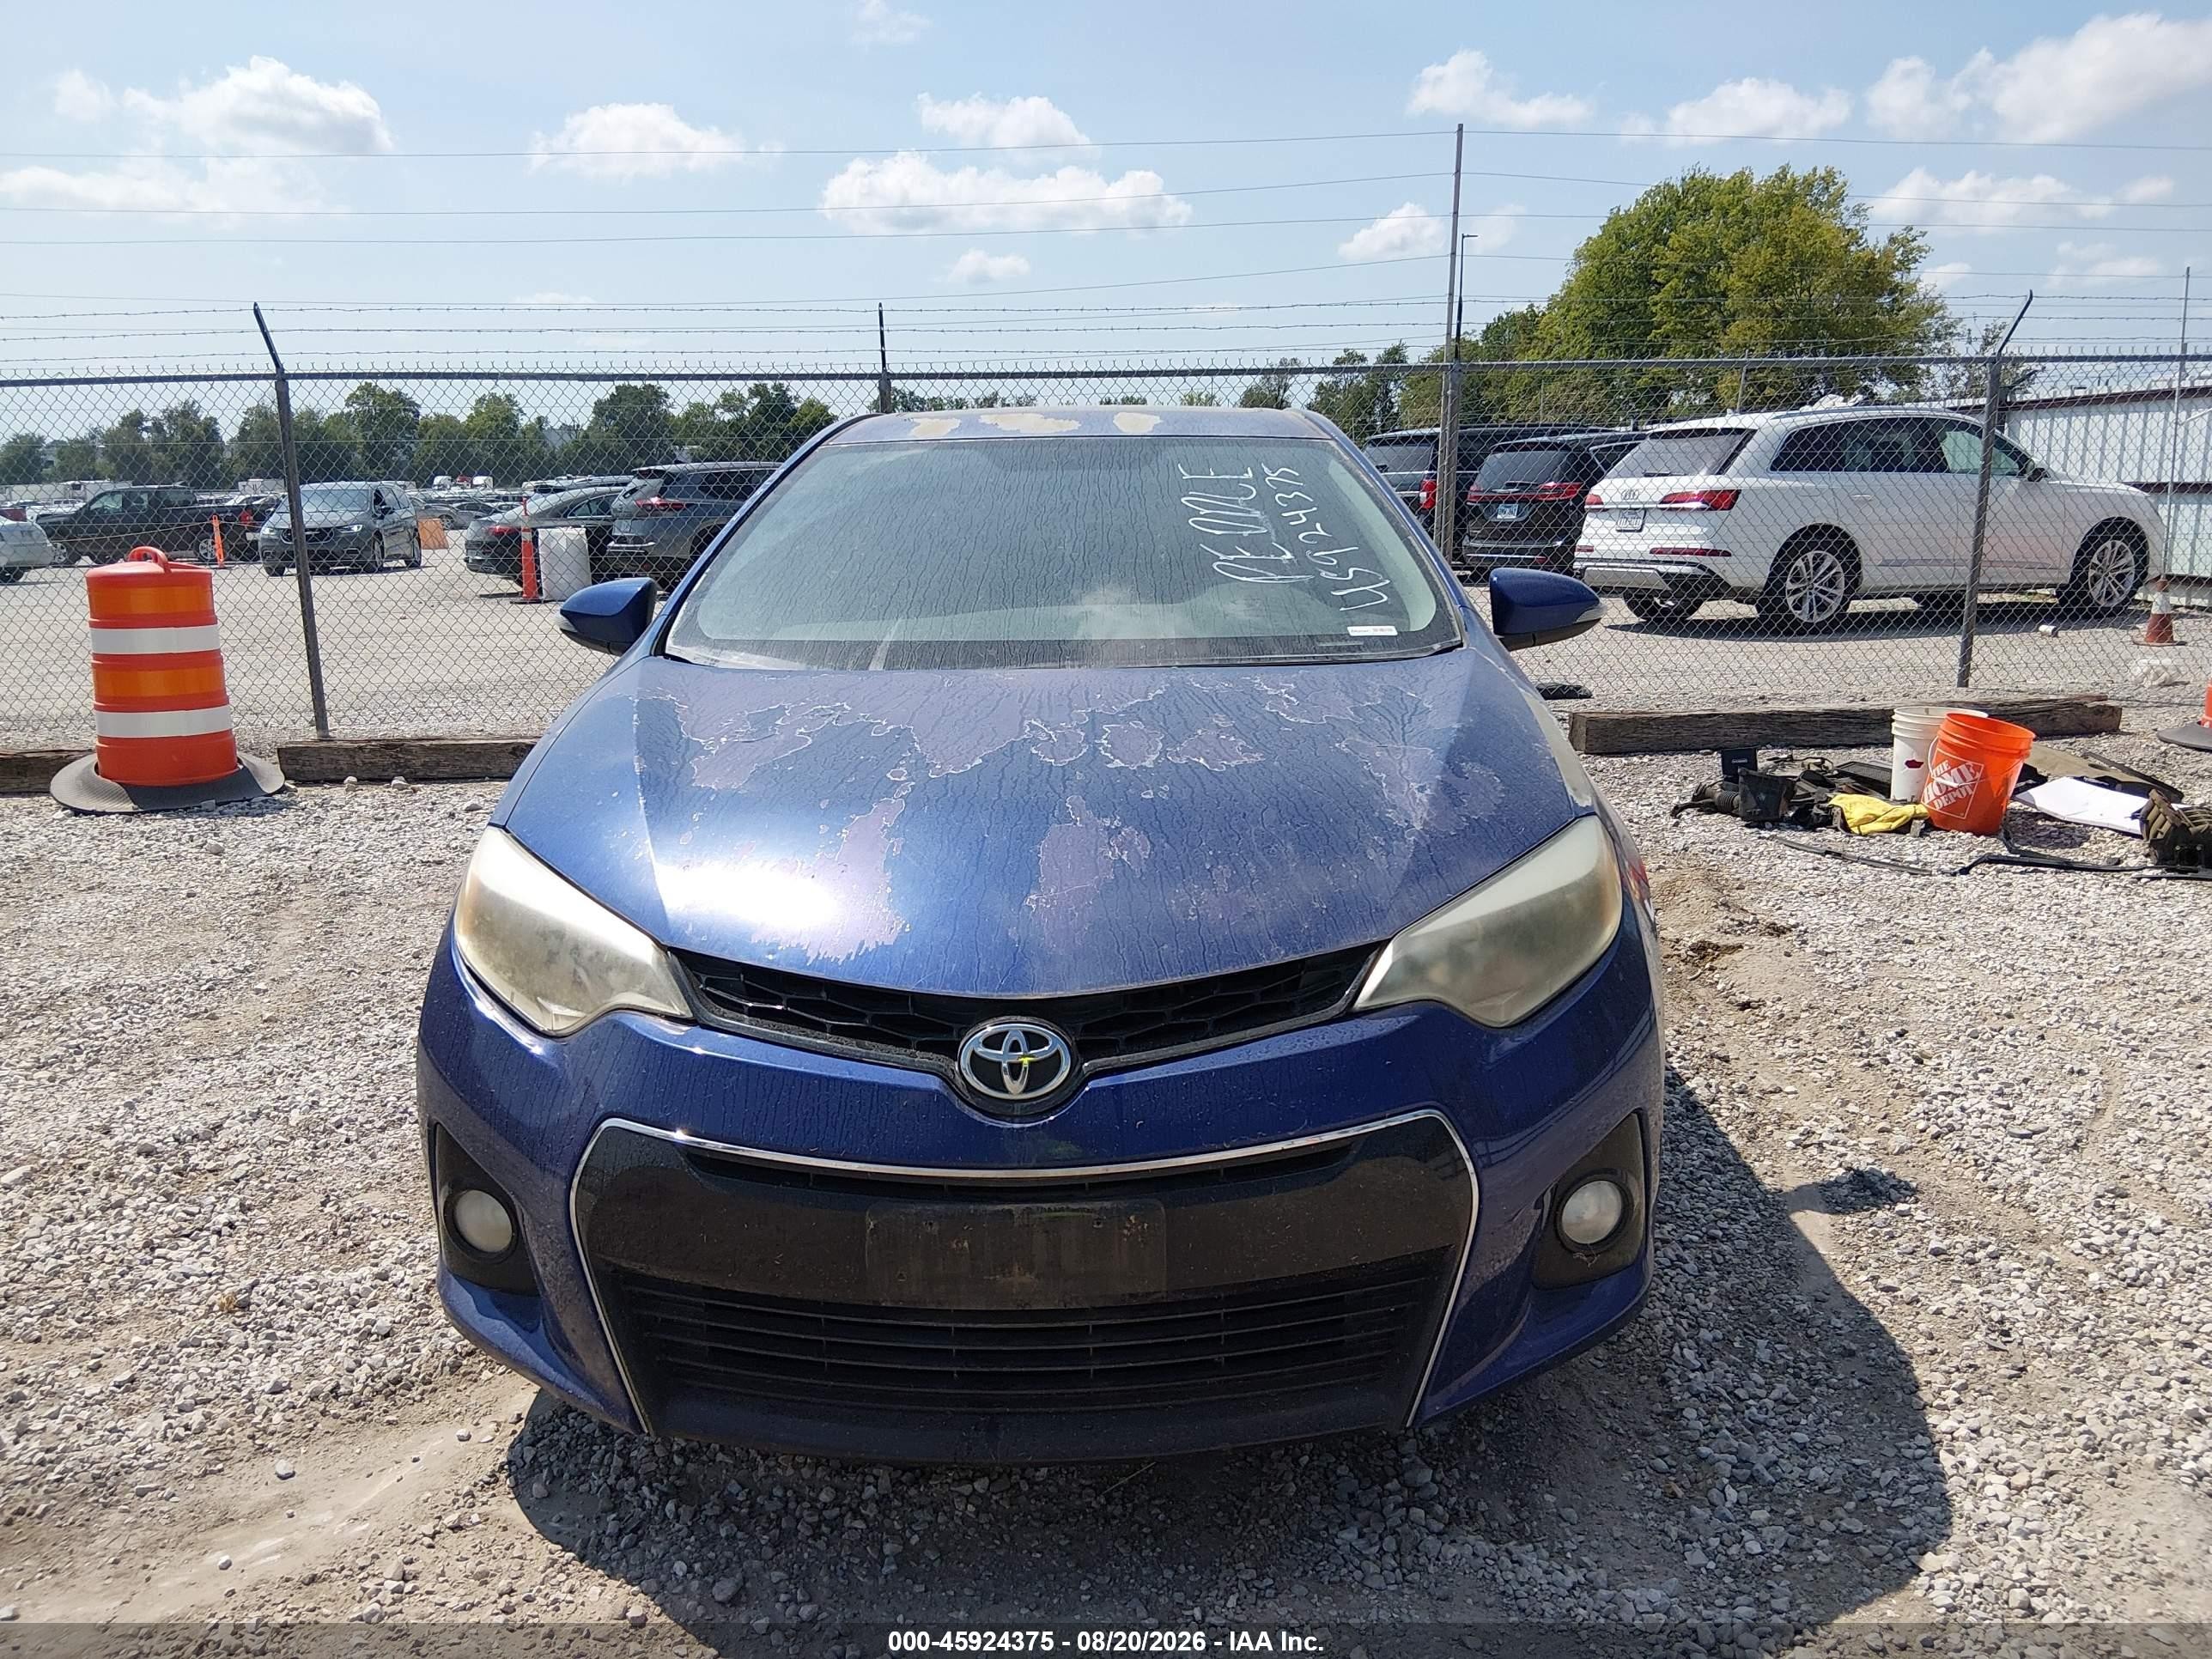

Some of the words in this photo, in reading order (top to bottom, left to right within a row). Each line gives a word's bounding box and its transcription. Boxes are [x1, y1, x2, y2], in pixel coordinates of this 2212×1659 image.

[1261, 462, 1391, 611] 45924375
[1923, 762, 1980, 805] HOME
[1932, 759, 1951, 778] THE
[1933, 783, 1974, 811] DEPOT
